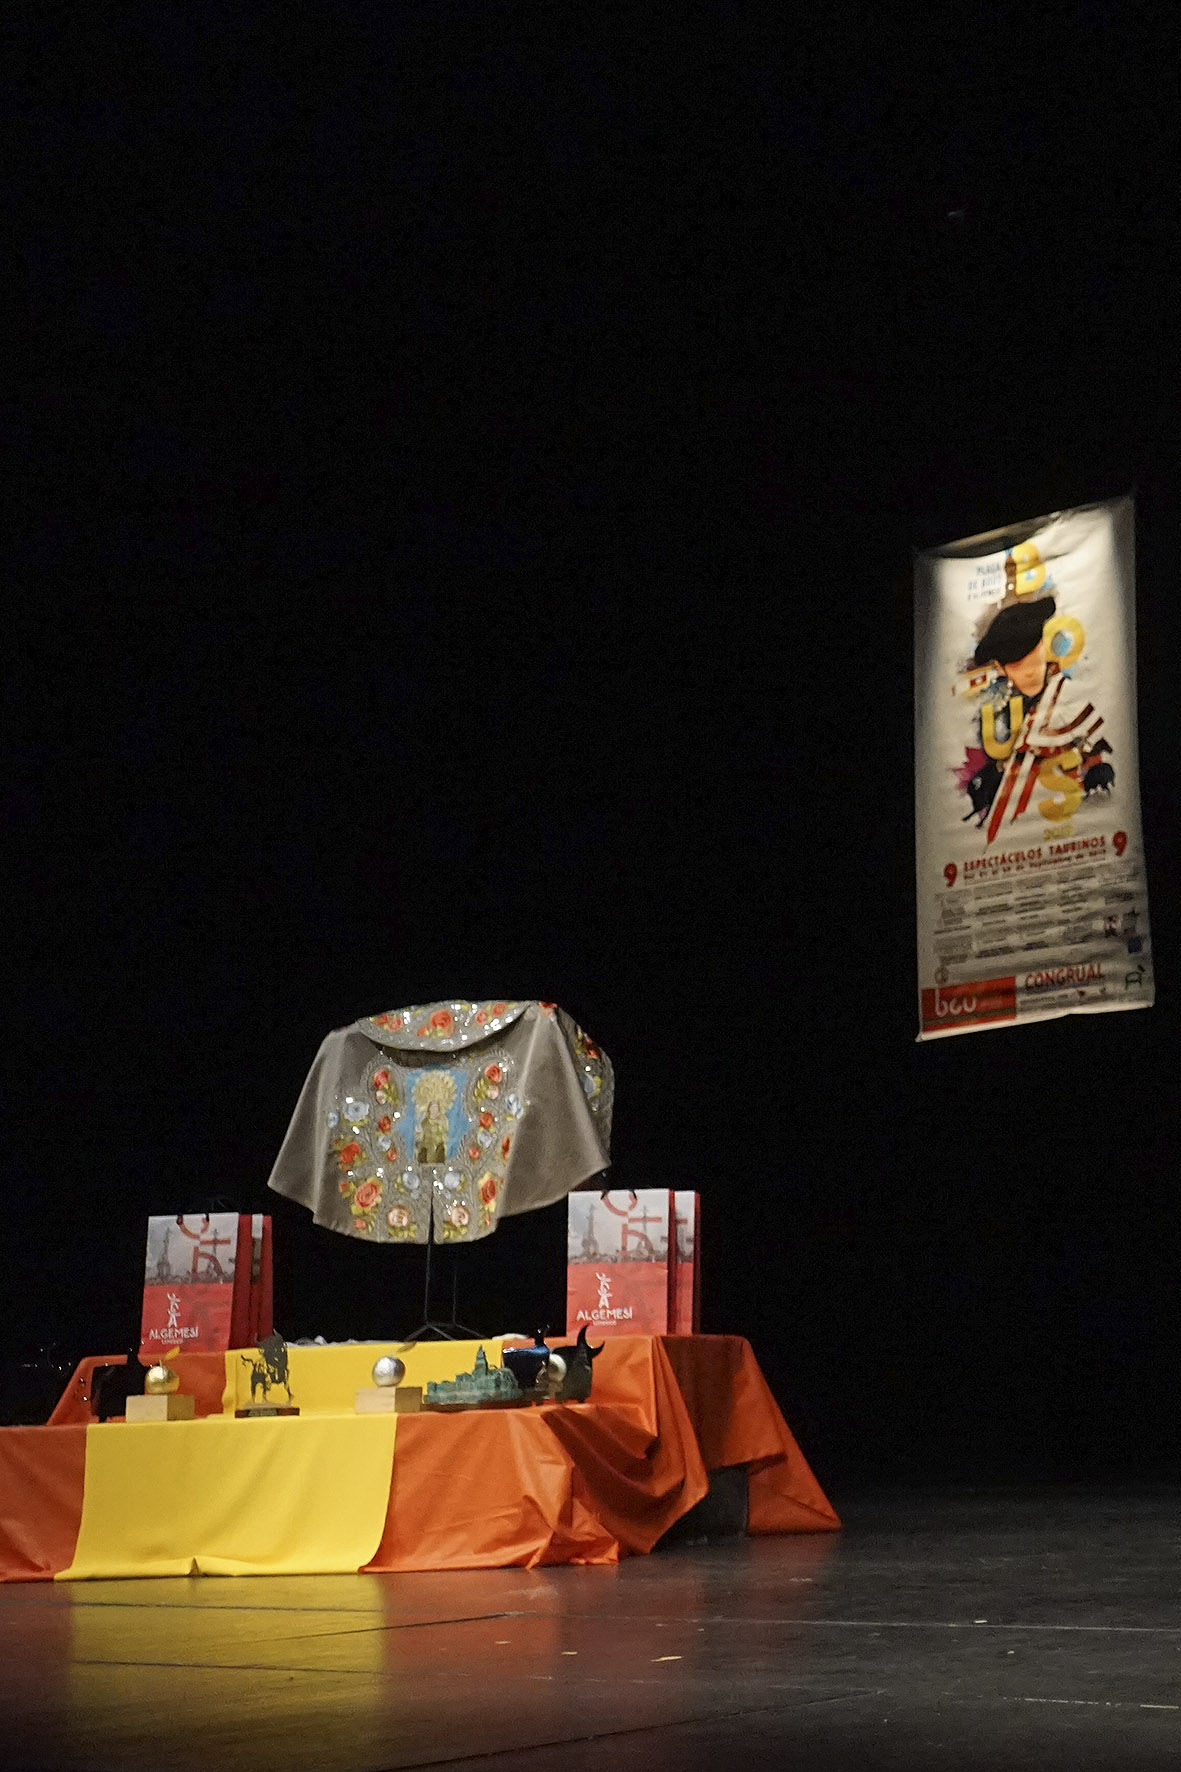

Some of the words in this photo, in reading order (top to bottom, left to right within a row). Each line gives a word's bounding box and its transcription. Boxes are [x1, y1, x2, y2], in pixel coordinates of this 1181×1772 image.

[943, 862, 958, 888] 9
[1112, 830, 1127, 857] 9
[1024, 962, 1105, 990] CONGRUAL
